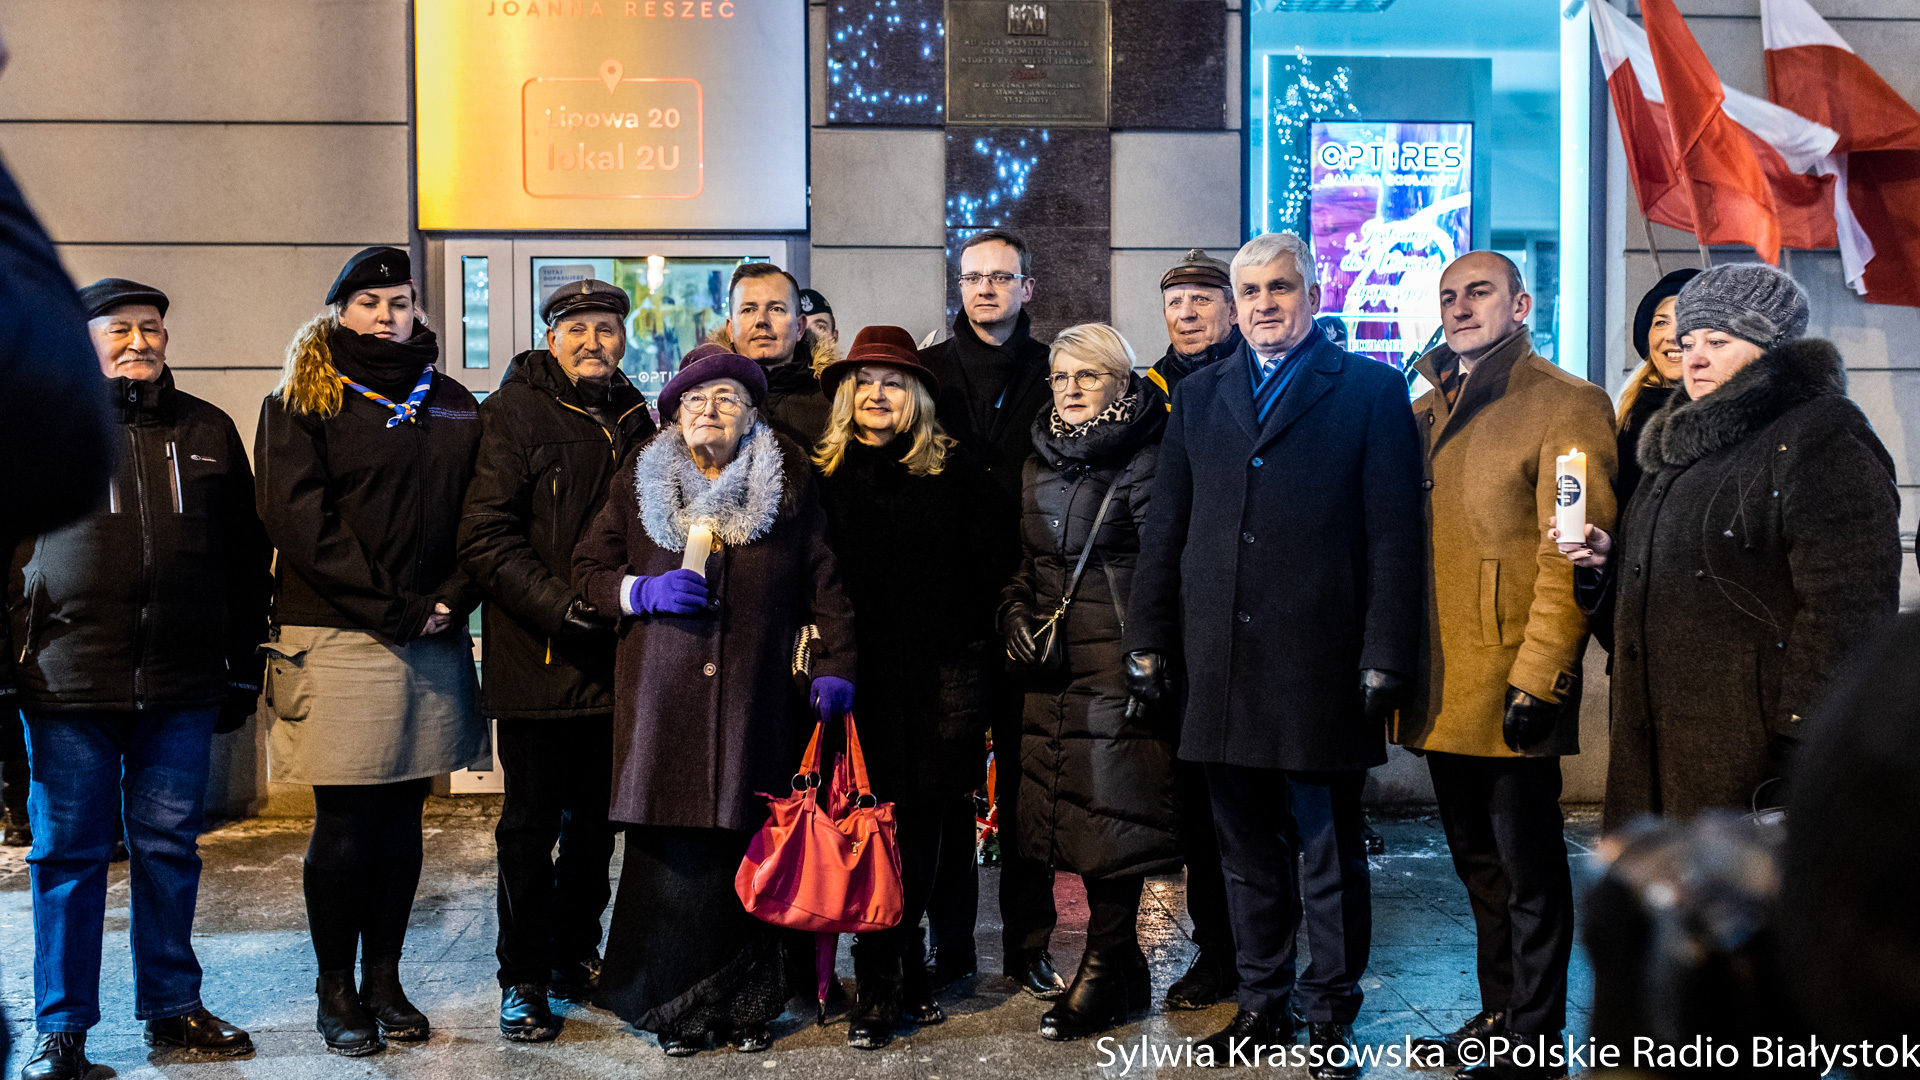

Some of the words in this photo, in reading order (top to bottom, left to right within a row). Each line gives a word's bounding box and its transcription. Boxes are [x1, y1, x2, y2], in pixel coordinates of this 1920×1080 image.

[488, 0, 604, 17] JOANNA
[546, 105, 639, 133] Lipowa
[648, 108, 681, 129] 20
[548, 142, 624, 171] lokal
[637, 144, 681, 171] 2U
[1320, 143, 1464, 170] OPTIRES
[638, 371, 680, 383] OPTI
